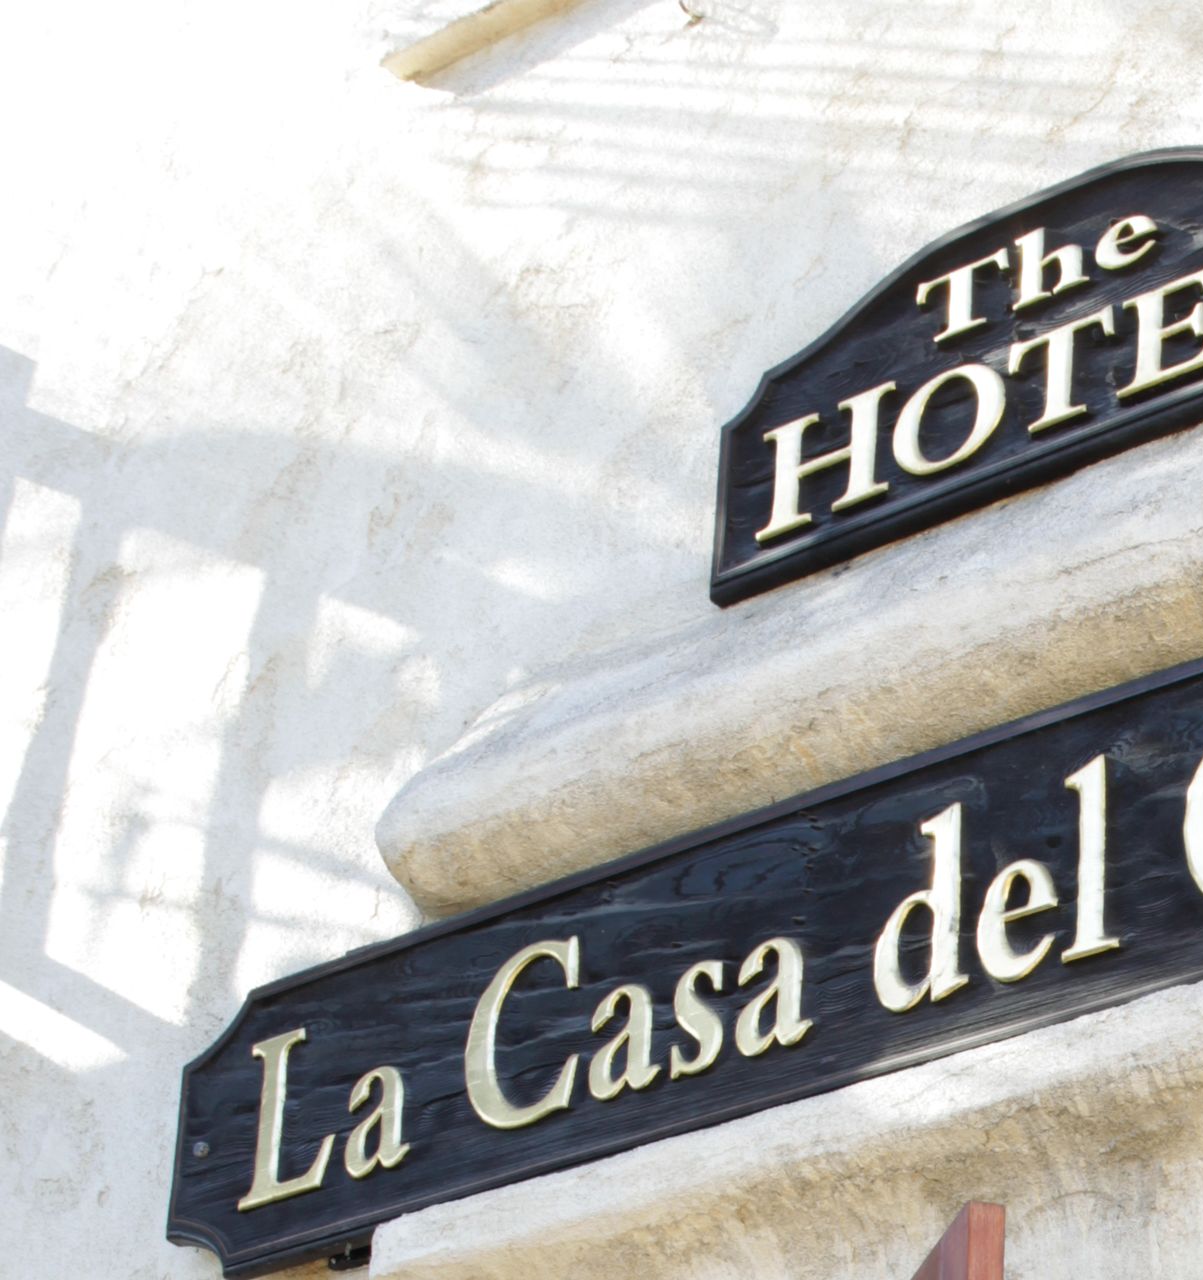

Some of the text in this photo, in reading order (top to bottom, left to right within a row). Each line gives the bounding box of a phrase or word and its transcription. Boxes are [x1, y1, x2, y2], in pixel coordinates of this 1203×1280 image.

[916, 215, 1158, 343] The
[238, 1027, 412, 1210] La
[463, 935, 814, 1129] Casa
[873, 754, 1122, 1012] del
